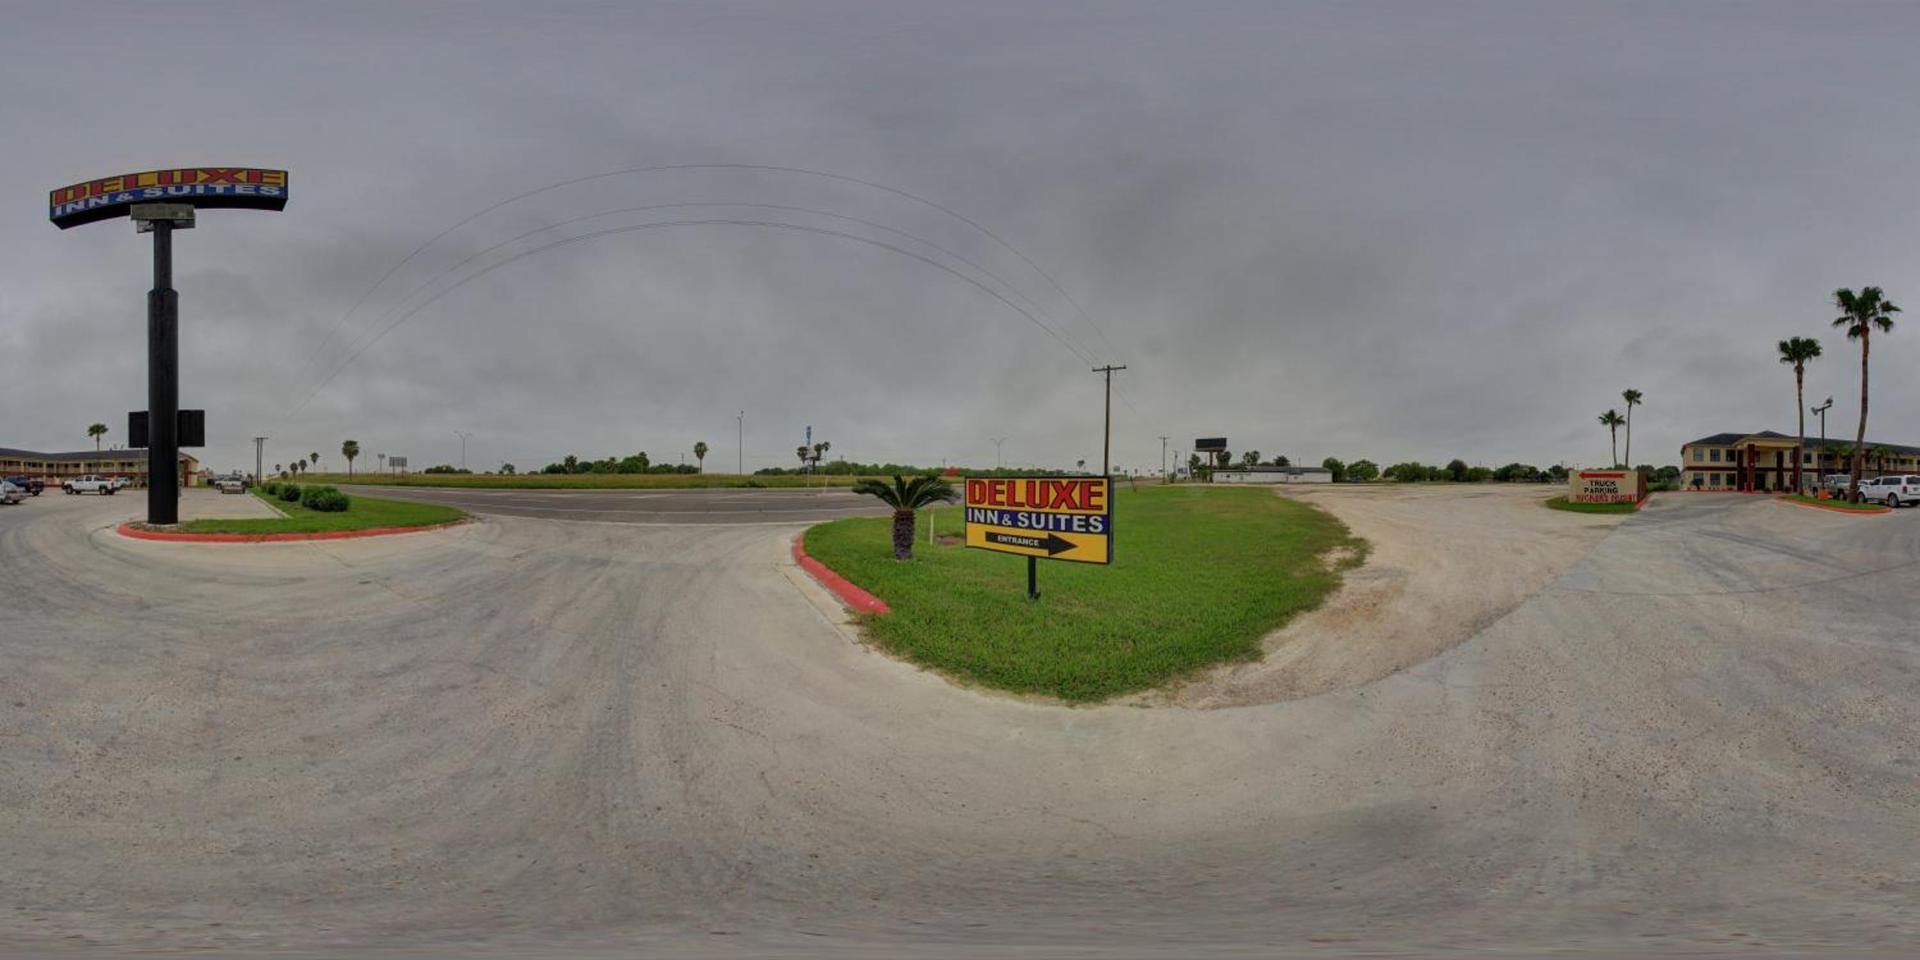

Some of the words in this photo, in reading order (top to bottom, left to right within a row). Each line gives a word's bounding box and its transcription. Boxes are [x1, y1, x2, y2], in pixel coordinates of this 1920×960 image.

[54, 168, 285, 205] DELUXE
[56, 195, 109, 216] INN
[116, 192, 133, 202] &
[143, 184, 281, 198] SUITES
[968, 480, 1104, 510] DELUXE
[968, 508, 999, 525] INN
[1001, 513, 1012, 526] &
[1017, 512, 1104, 533] SUITES
[997, 535, 1040, 547] ENTRANCE
